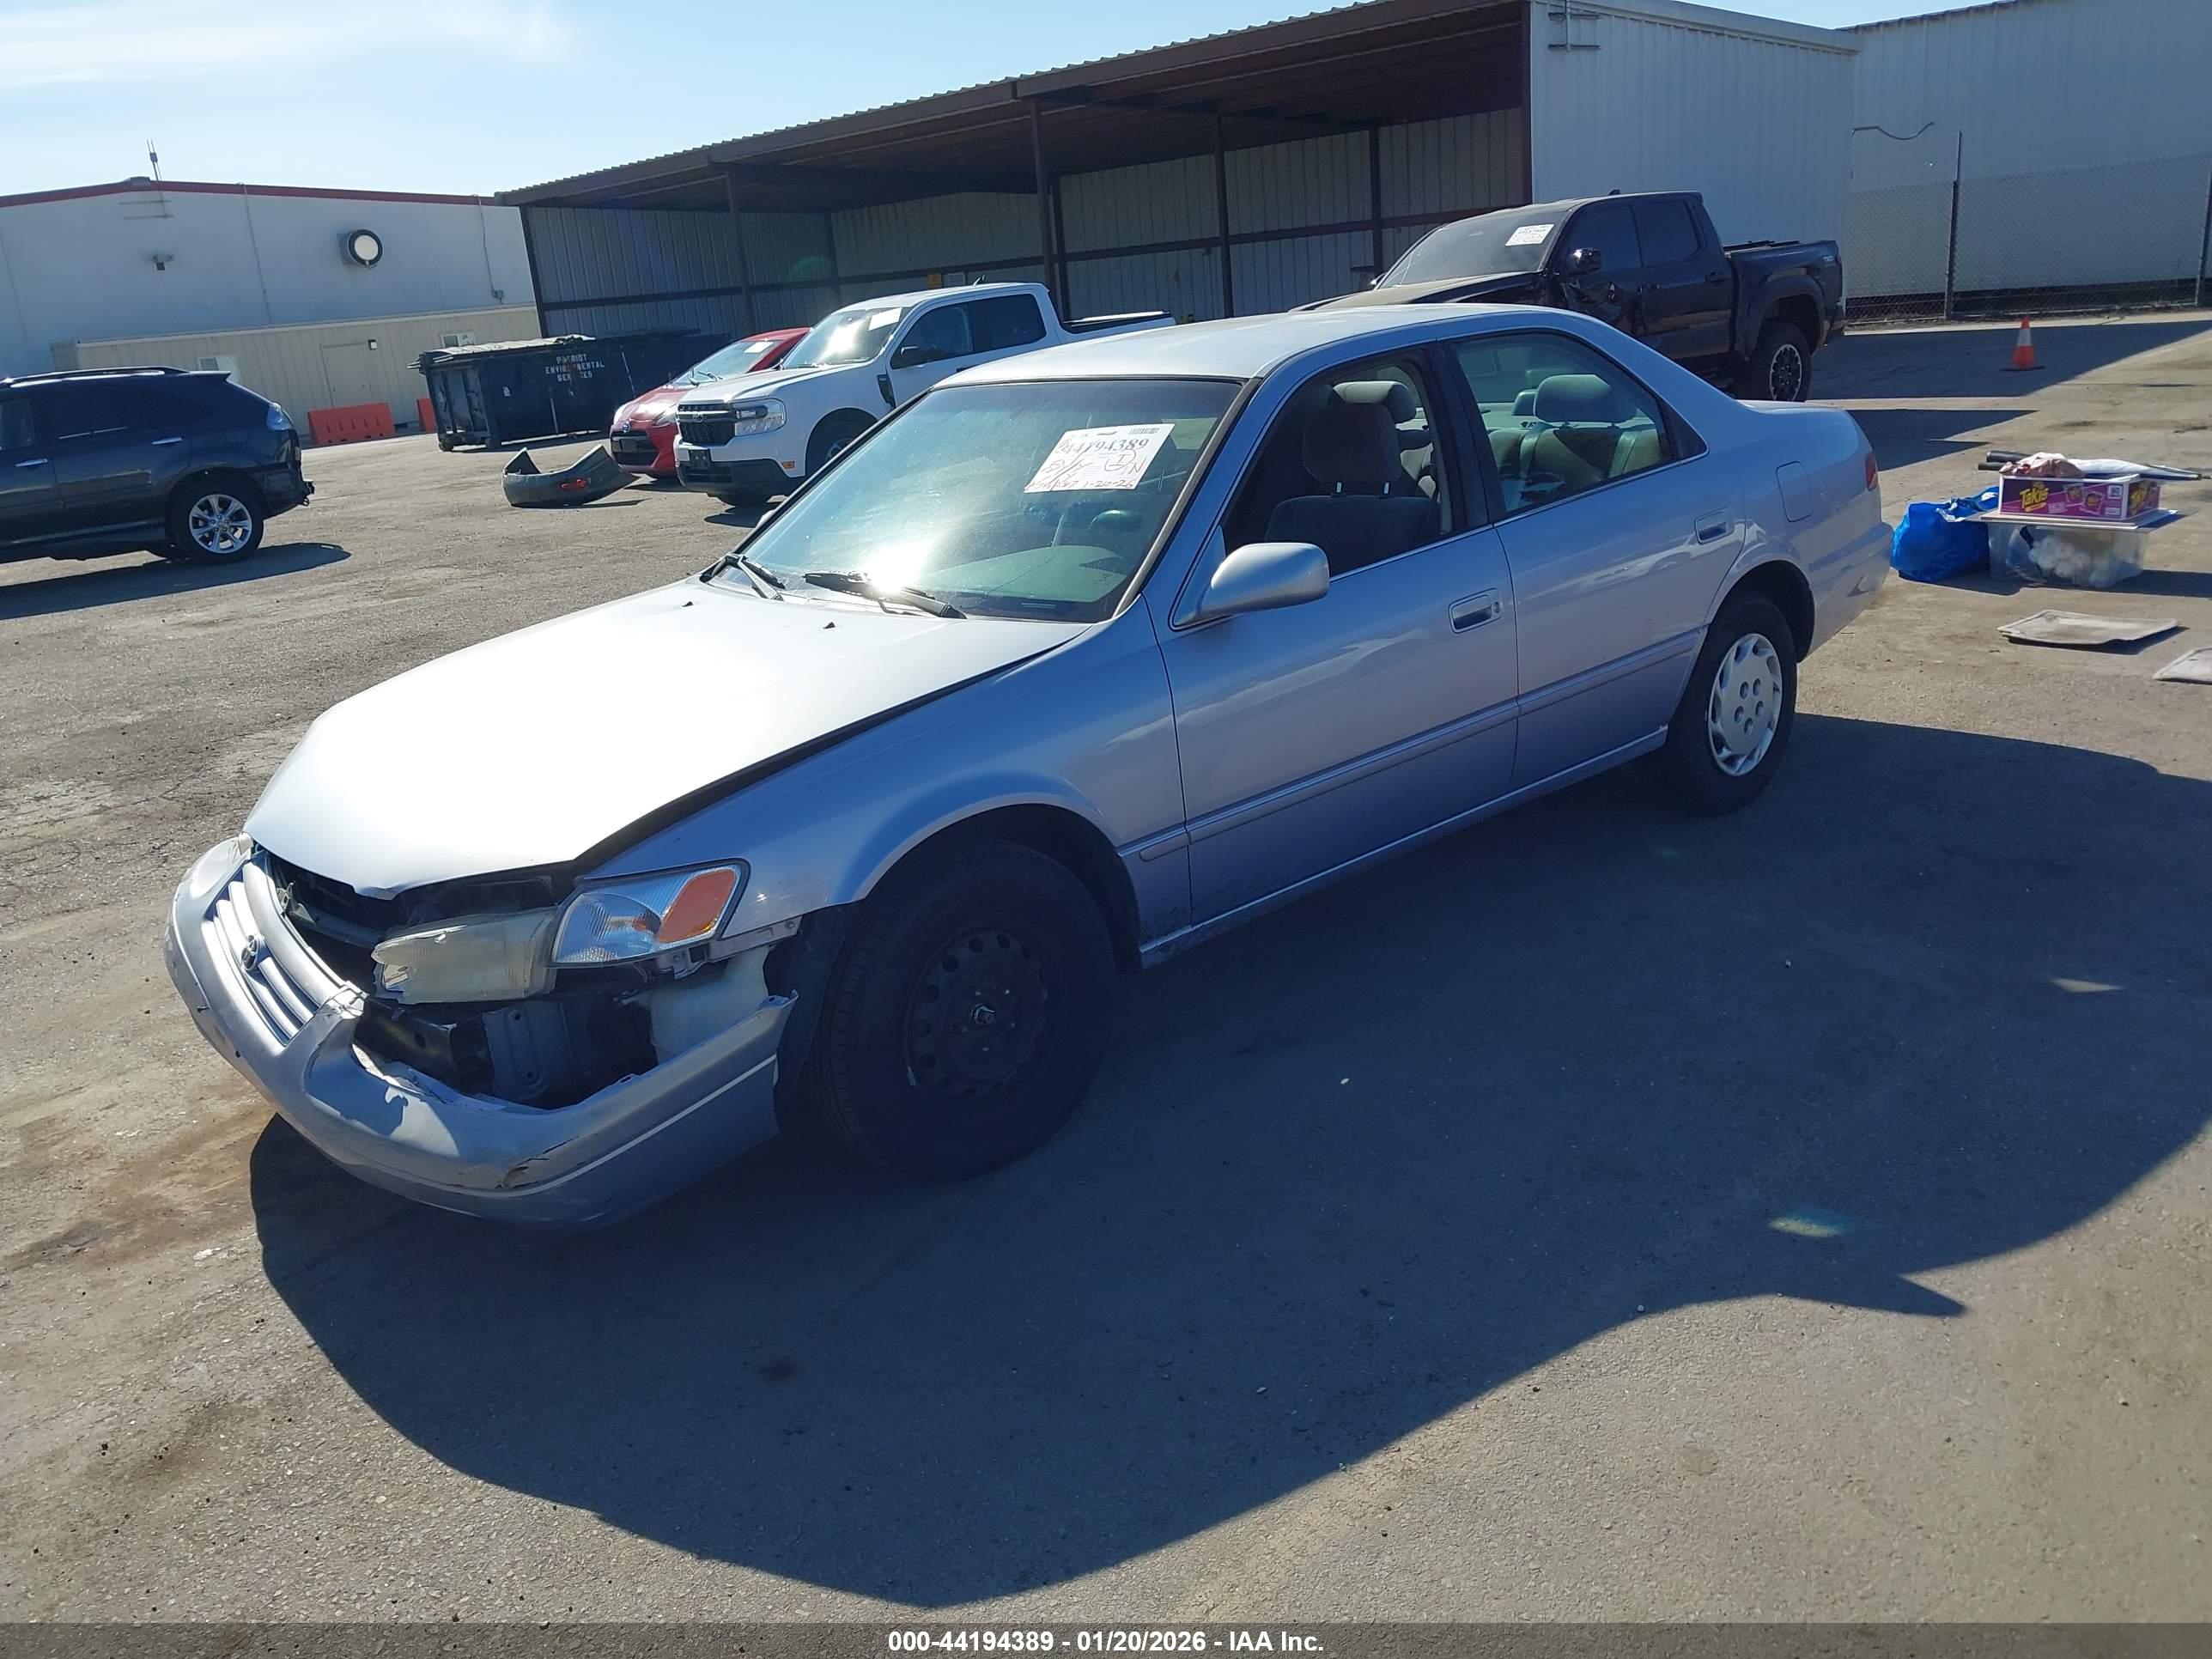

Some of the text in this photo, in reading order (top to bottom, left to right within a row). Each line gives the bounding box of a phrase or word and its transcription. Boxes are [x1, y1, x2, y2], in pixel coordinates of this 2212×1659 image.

[556, 353, 587, 364] PATRIOT
[545, 360, 605, 374] ENVIRMENTAL
[557, 370, 593, 382] SERES
[2019, 486, 2050, 509] Takis
